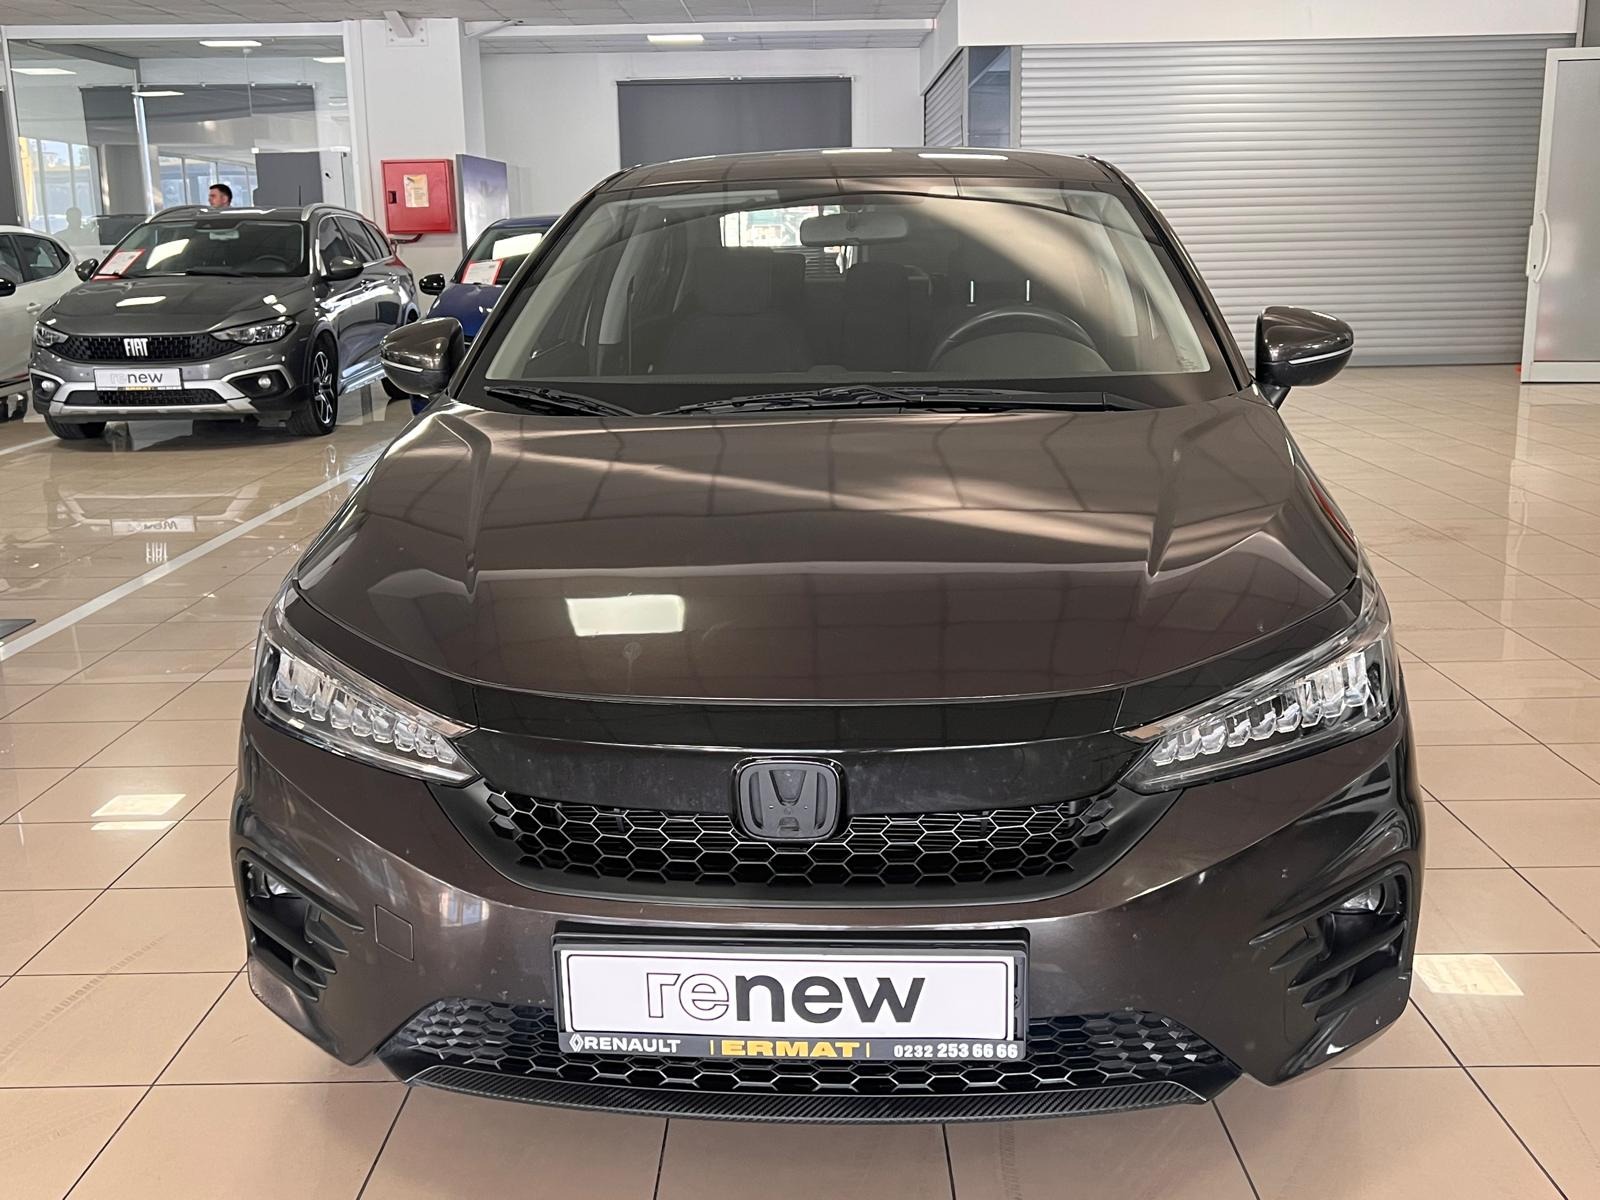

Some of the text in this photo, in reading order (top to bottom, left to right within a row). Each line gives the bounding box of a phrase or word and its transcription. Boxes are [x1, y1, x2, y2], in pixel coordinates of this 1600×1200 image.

[124, 338, 148, 356] FIAT
[646, 972, 926, 1024] renew
[584, 1036, 1018, 1059] RENAULT ERMAT 0232 253 66 66
